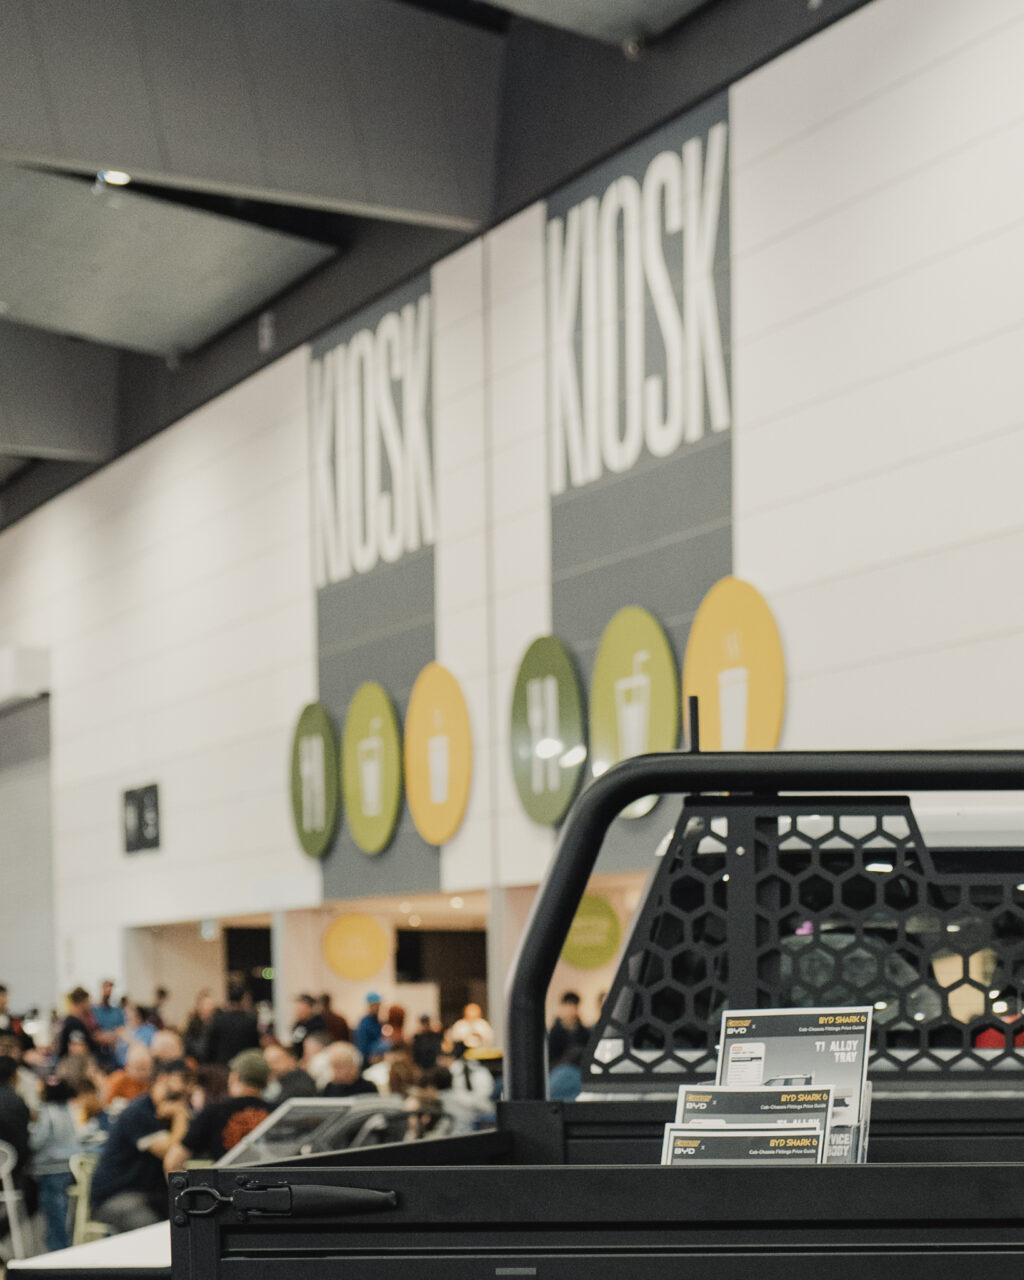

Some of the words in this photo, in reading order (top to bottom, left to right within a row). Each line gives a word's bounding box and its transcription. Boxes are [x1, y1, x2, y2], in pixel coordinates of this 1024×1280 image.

[547, 121, 732, 495] KIOSK
[310, 292, 437, 588] KIOSK
[819, 1016, 835, 1025] BYD
[835, 1015, 860, 1025] SHARK
[829, 1040, 859, 1052] ALLOY
[834, 1051, 858, 1063] TRAY
[780, 1094, 797, 1103] BYD
[797, 1093, 822, 1102] SHARK
[769, 1139, 785, 1147] BYD
[786, 1138, 811, 1147] SHARK
